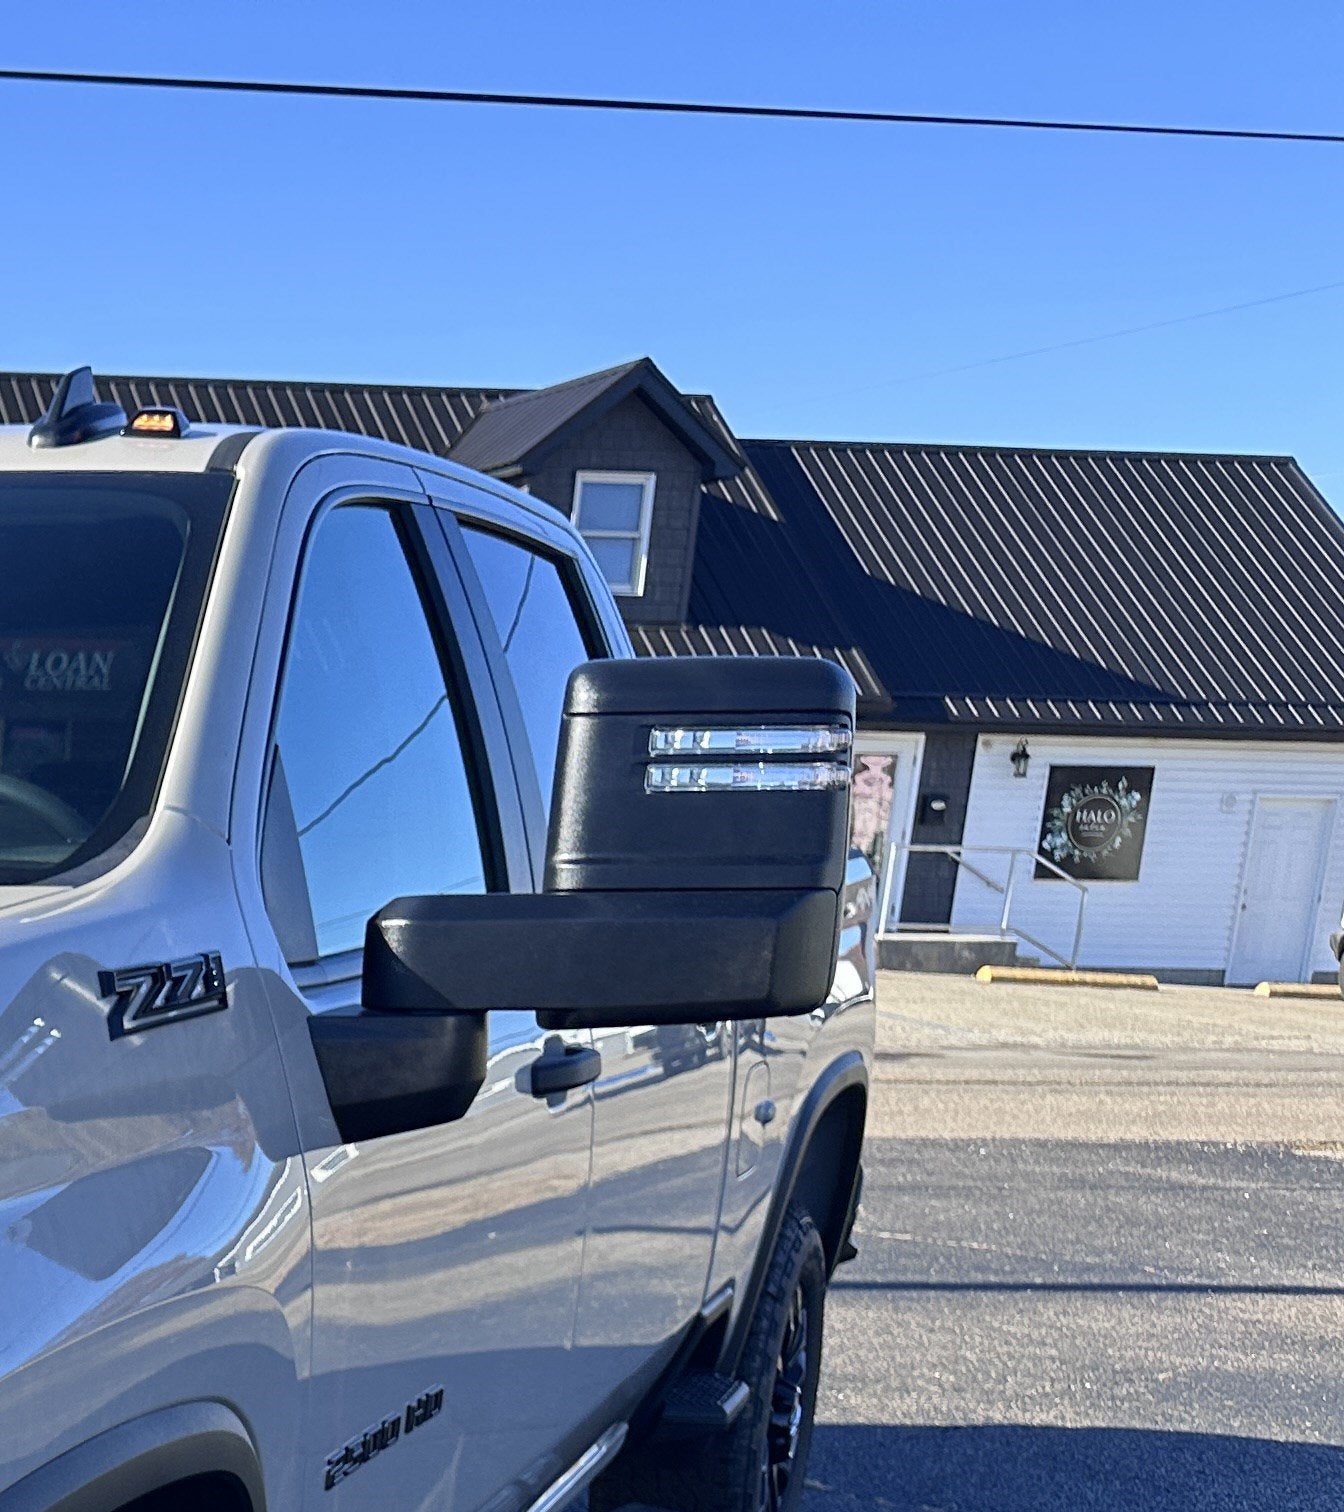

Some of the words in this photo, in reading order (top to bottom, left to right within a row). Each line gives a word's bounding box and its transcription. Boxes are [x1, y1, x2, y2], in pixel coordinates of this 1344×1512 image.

[26, 650, 115, 676] LOAN
[1075, 808, 1116, 824] HALO
[324, 1411, 402, 1491] 2500
[404, 1383, 445, 1434] HD
